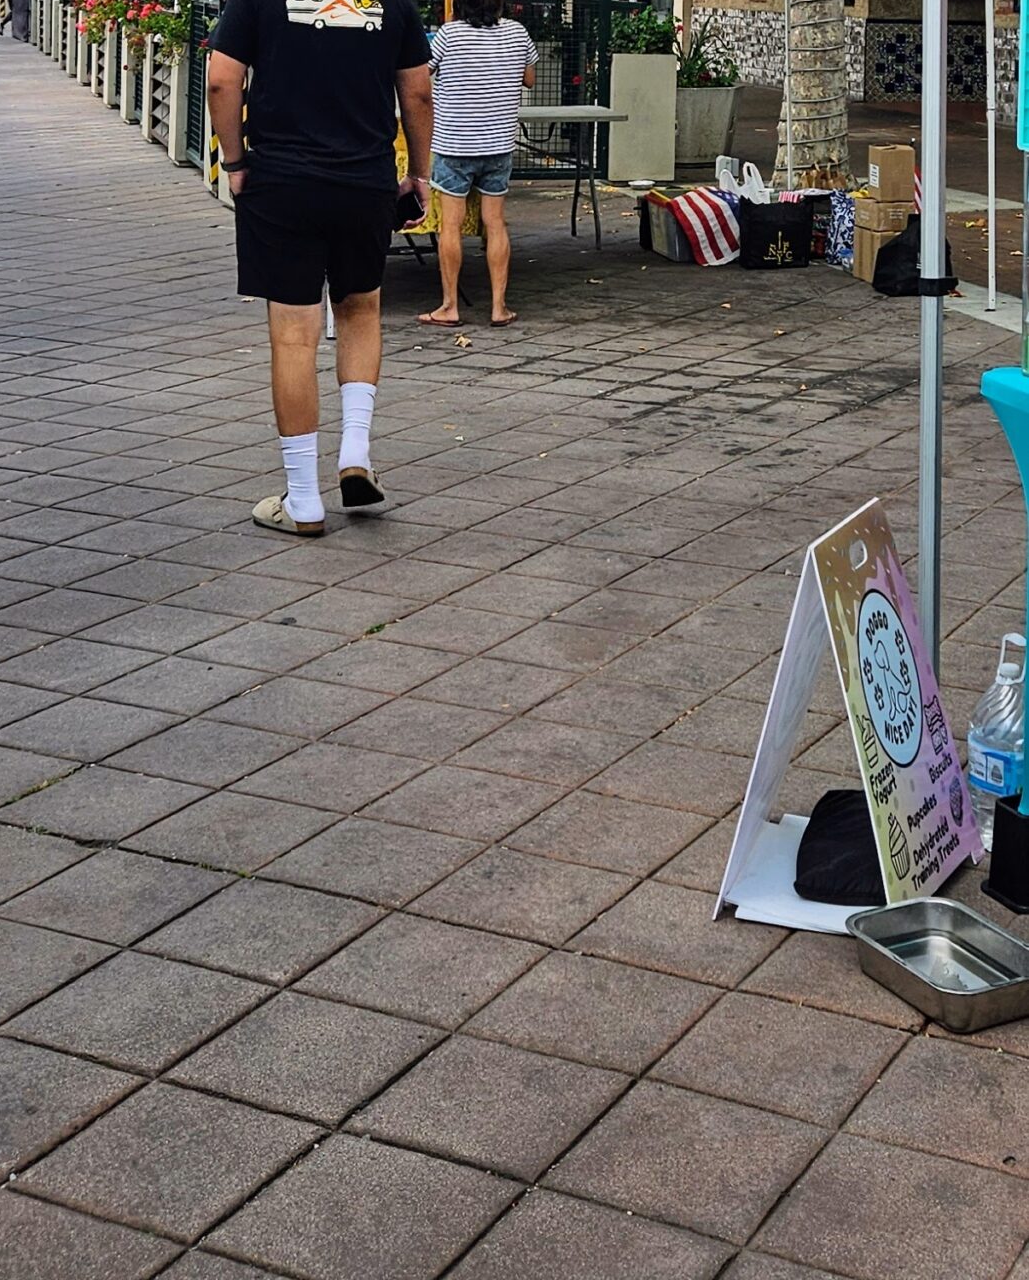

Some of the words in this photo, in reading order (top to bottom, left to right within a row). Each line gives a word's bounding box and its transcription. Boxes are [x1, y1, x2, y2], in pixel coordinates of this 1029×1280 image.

[865, 610, 889, 646] DOGGO
[884, 719, 904, 745] NICE
[869, 762, 894, 790] Frozen
[928, 753, 953, 784] Biscuits
[871, 777, 898, 808] Yogurt
[906, 793, 938, 832] Pupcakes
[912, 816, 950, 866] Dehydrated
[911, 856, 940, 891] Training
[937, 833, 960, 864] Treats
